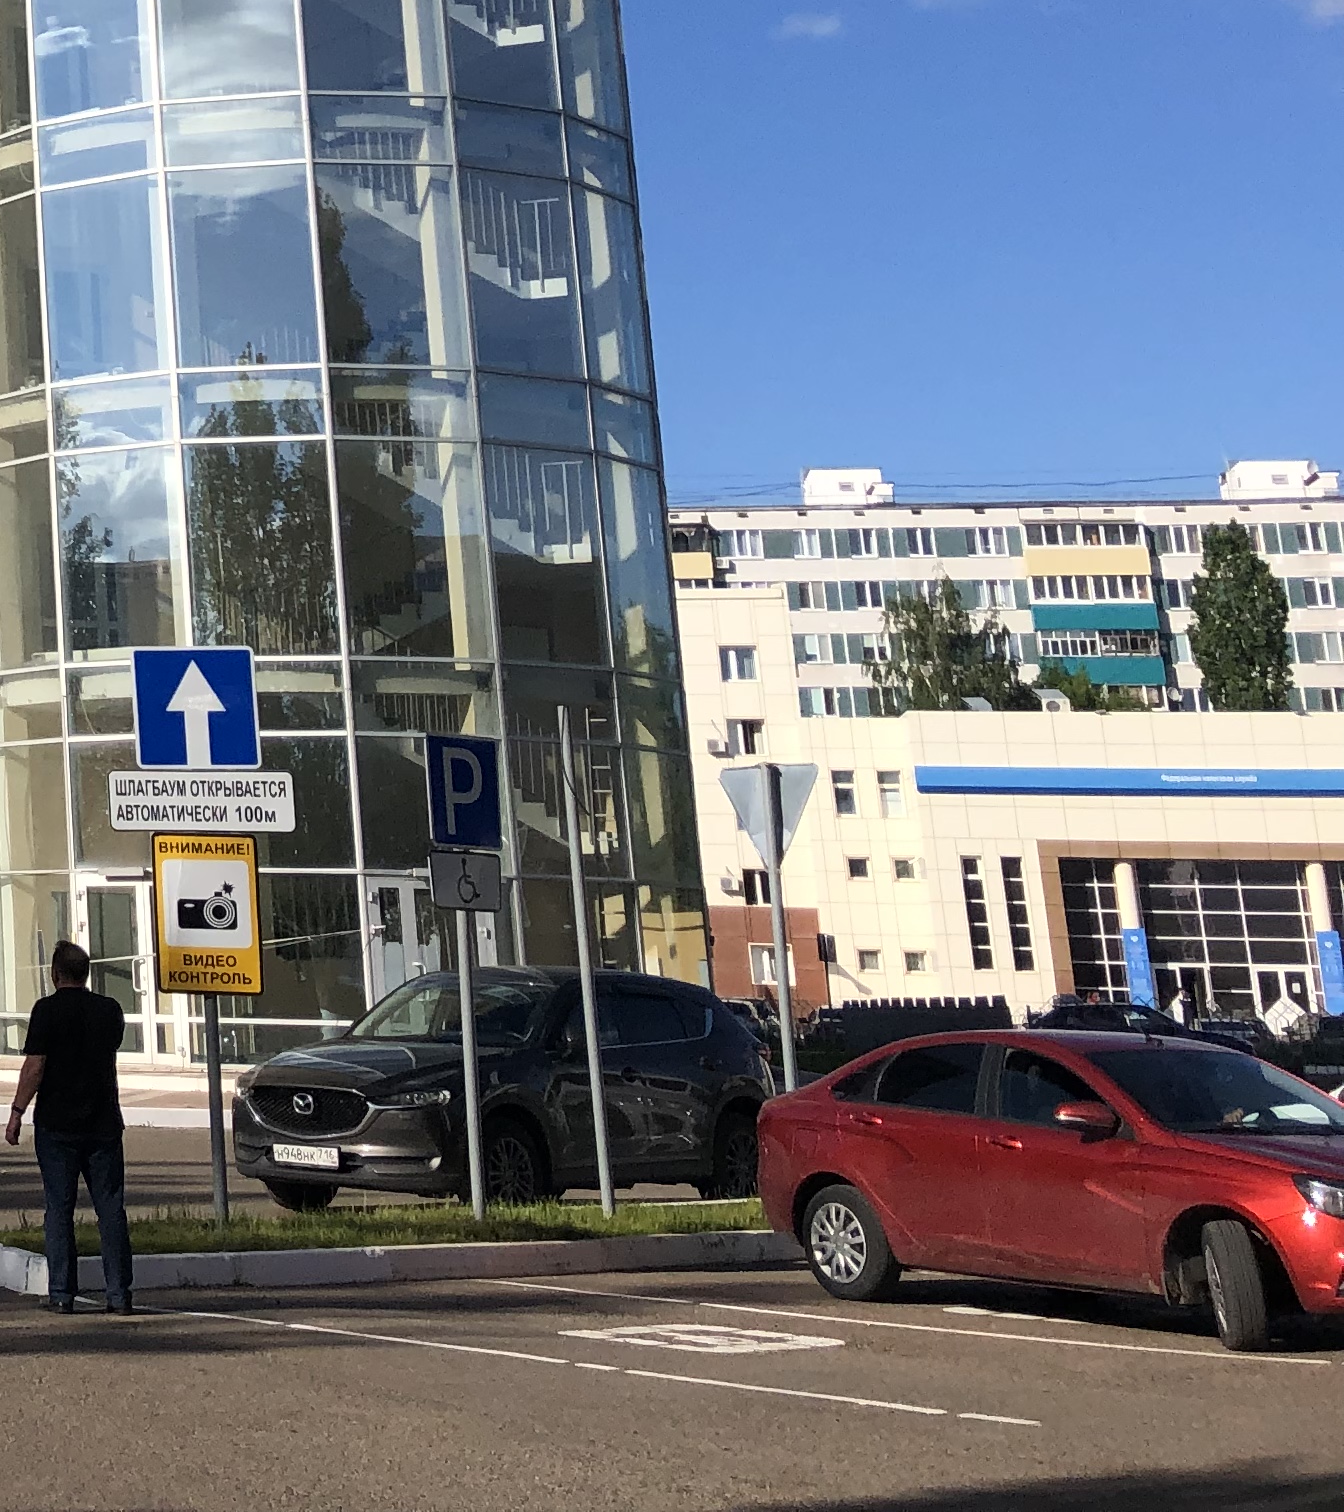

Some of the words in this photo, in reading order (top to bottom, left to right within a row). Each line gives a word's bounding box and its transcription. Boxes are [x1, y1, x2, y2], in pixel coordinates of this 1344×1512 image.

[115, 779, 187, 798] ШЛАГБАУМ
[190, 780, 287, 798] ОТКРЫВАЕТСЯ
[442, 747, 483, 836] P
[116, 804, 228, 823] АВТОМАТИЧЕСКИ
[235, 805, 277, 823] 100м
[159, 841, 250, 856] ВНИМАНИЕ!
[183, 954, 237, 969] ВИДЕО
[169, 971, 253, 985] КОНТРОЛЬ
